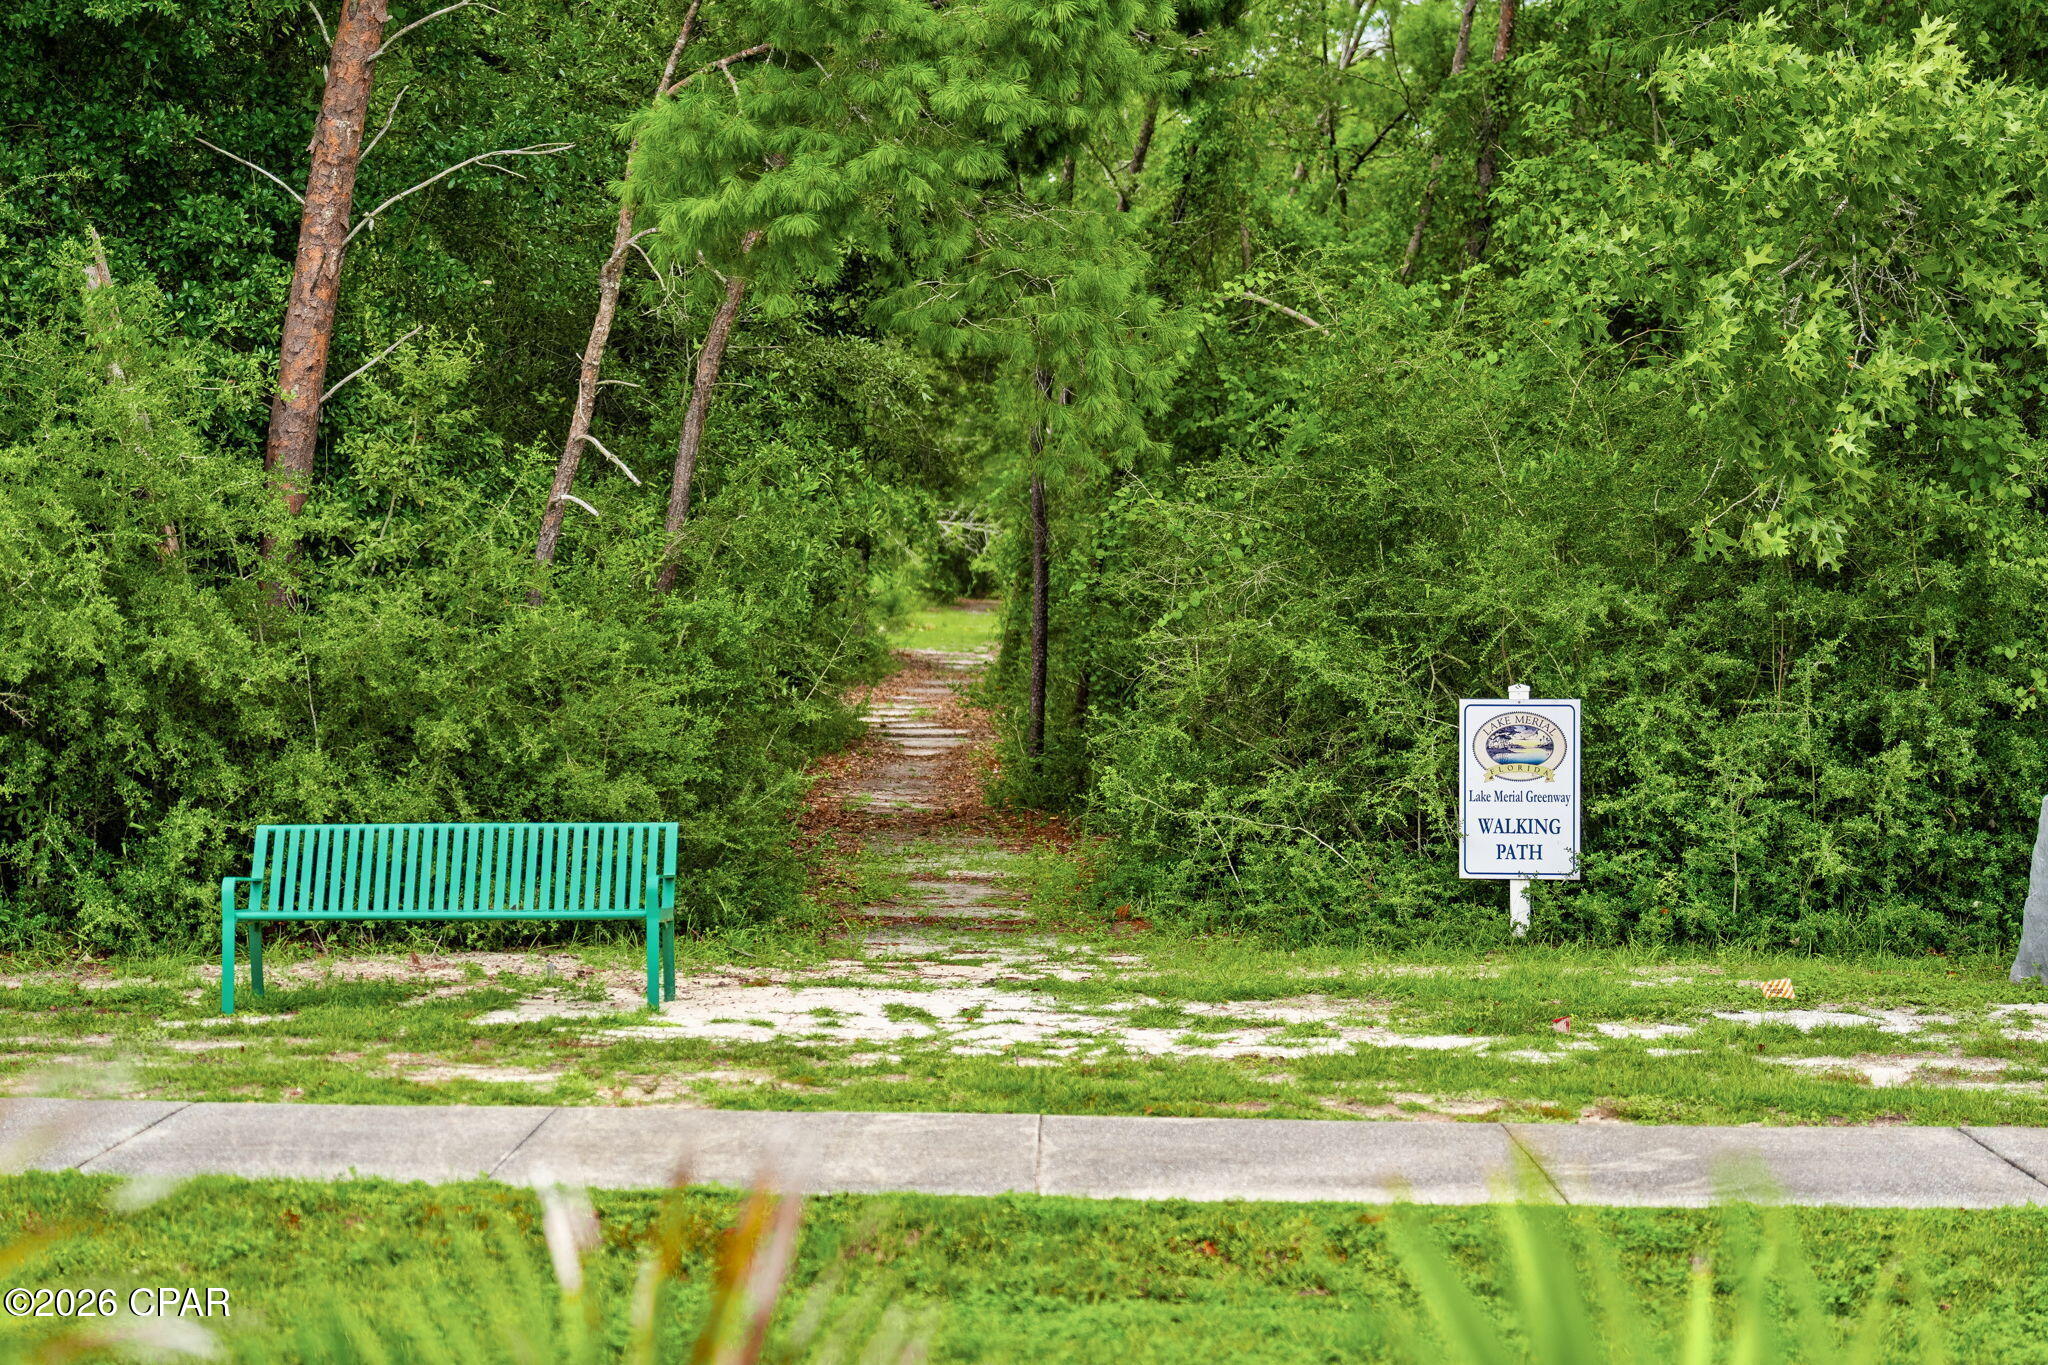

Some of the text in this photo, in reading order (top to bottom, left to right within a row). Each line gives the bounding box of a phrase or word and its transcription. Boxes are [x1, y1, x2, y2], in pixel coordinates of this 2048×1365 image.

[1483, 715, 1557, 737] LAKE MERIAL
[1490, 765, 1549, 776] FLORIDA
[1469, 790, 1571, 806] Lake Merial Greenway
[1478, 818, 1561, 834] WALKING
[1496, 844, 1543, 860] PATH
